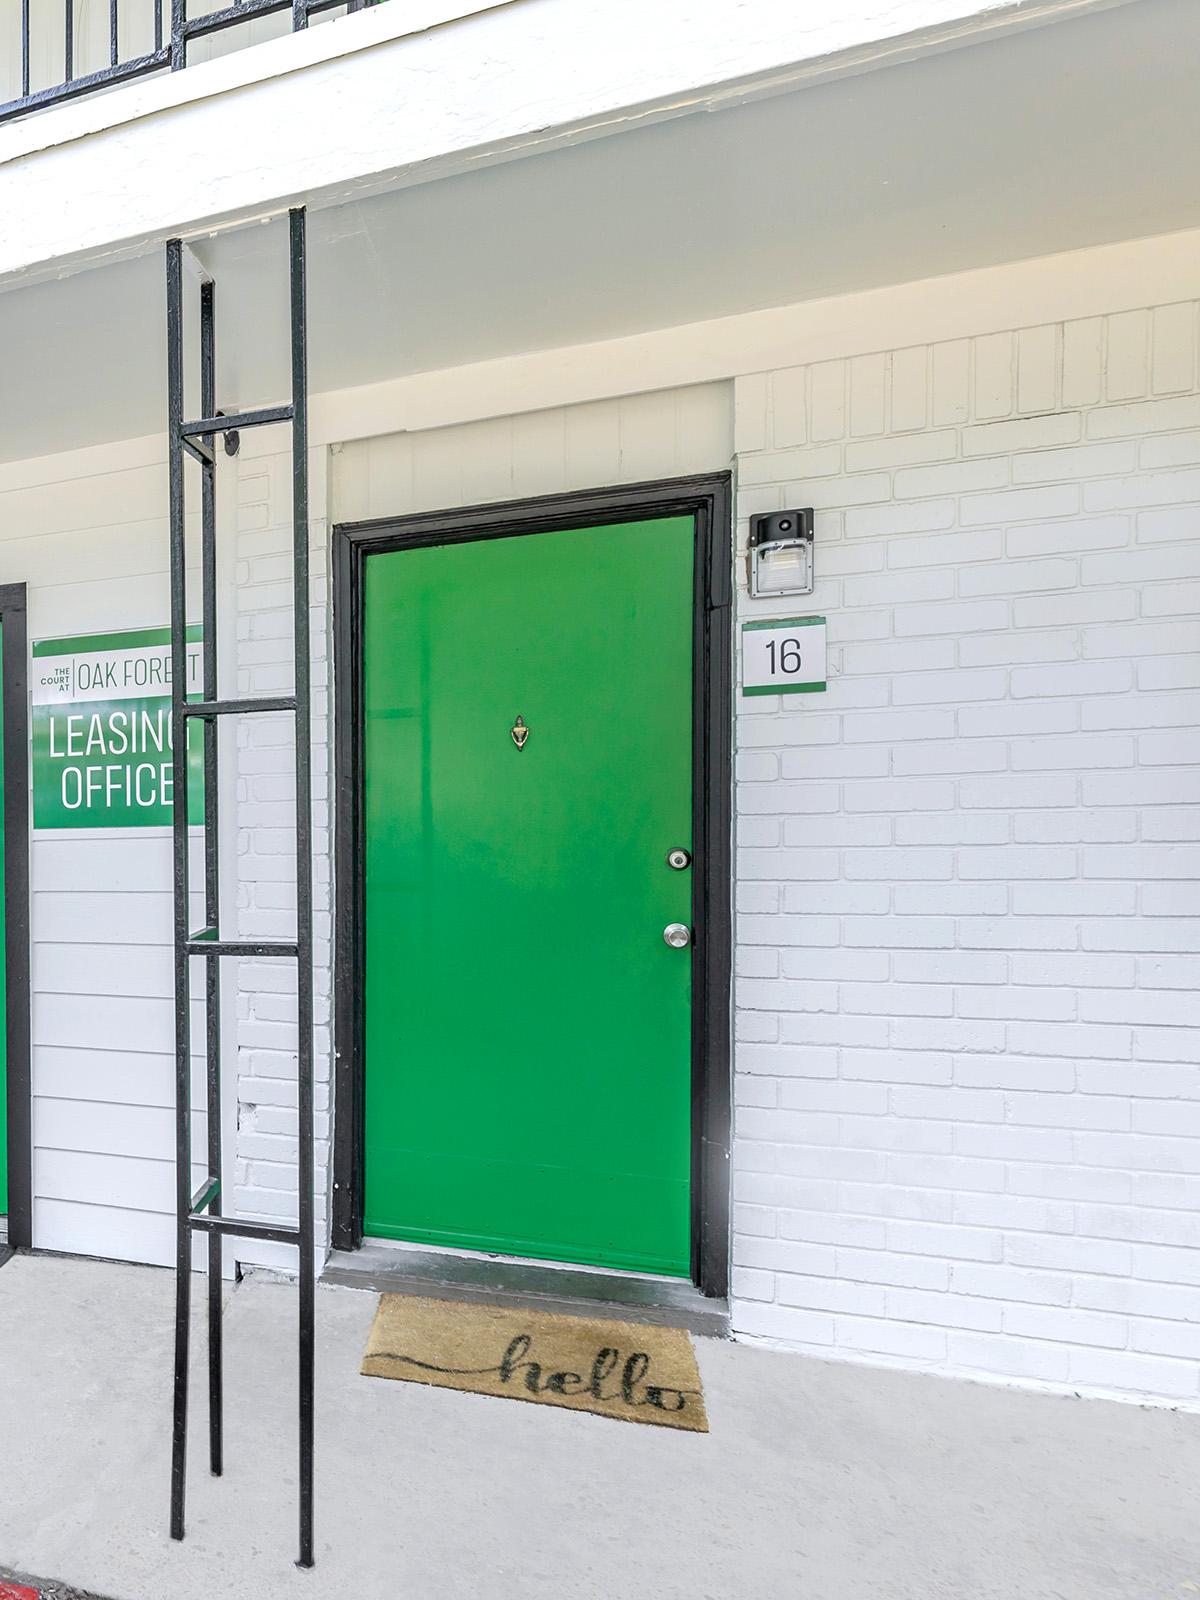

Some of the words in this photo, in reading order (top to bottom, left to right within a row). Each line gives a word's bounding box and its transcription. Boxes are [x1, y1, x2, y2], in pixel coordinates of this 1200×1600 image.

[55, 667, 70, 676] THE
[78, 661, 117, 690] OAK
[124, 654, 200, 687] FORET
[765, 638, 802, 675] 16
[40, 676, 70, 686] COURT
[58, 684, 70, 692] AT
[61, 763, 174, 809] OFFICE
[492, 1333, 698, 1412] hello
